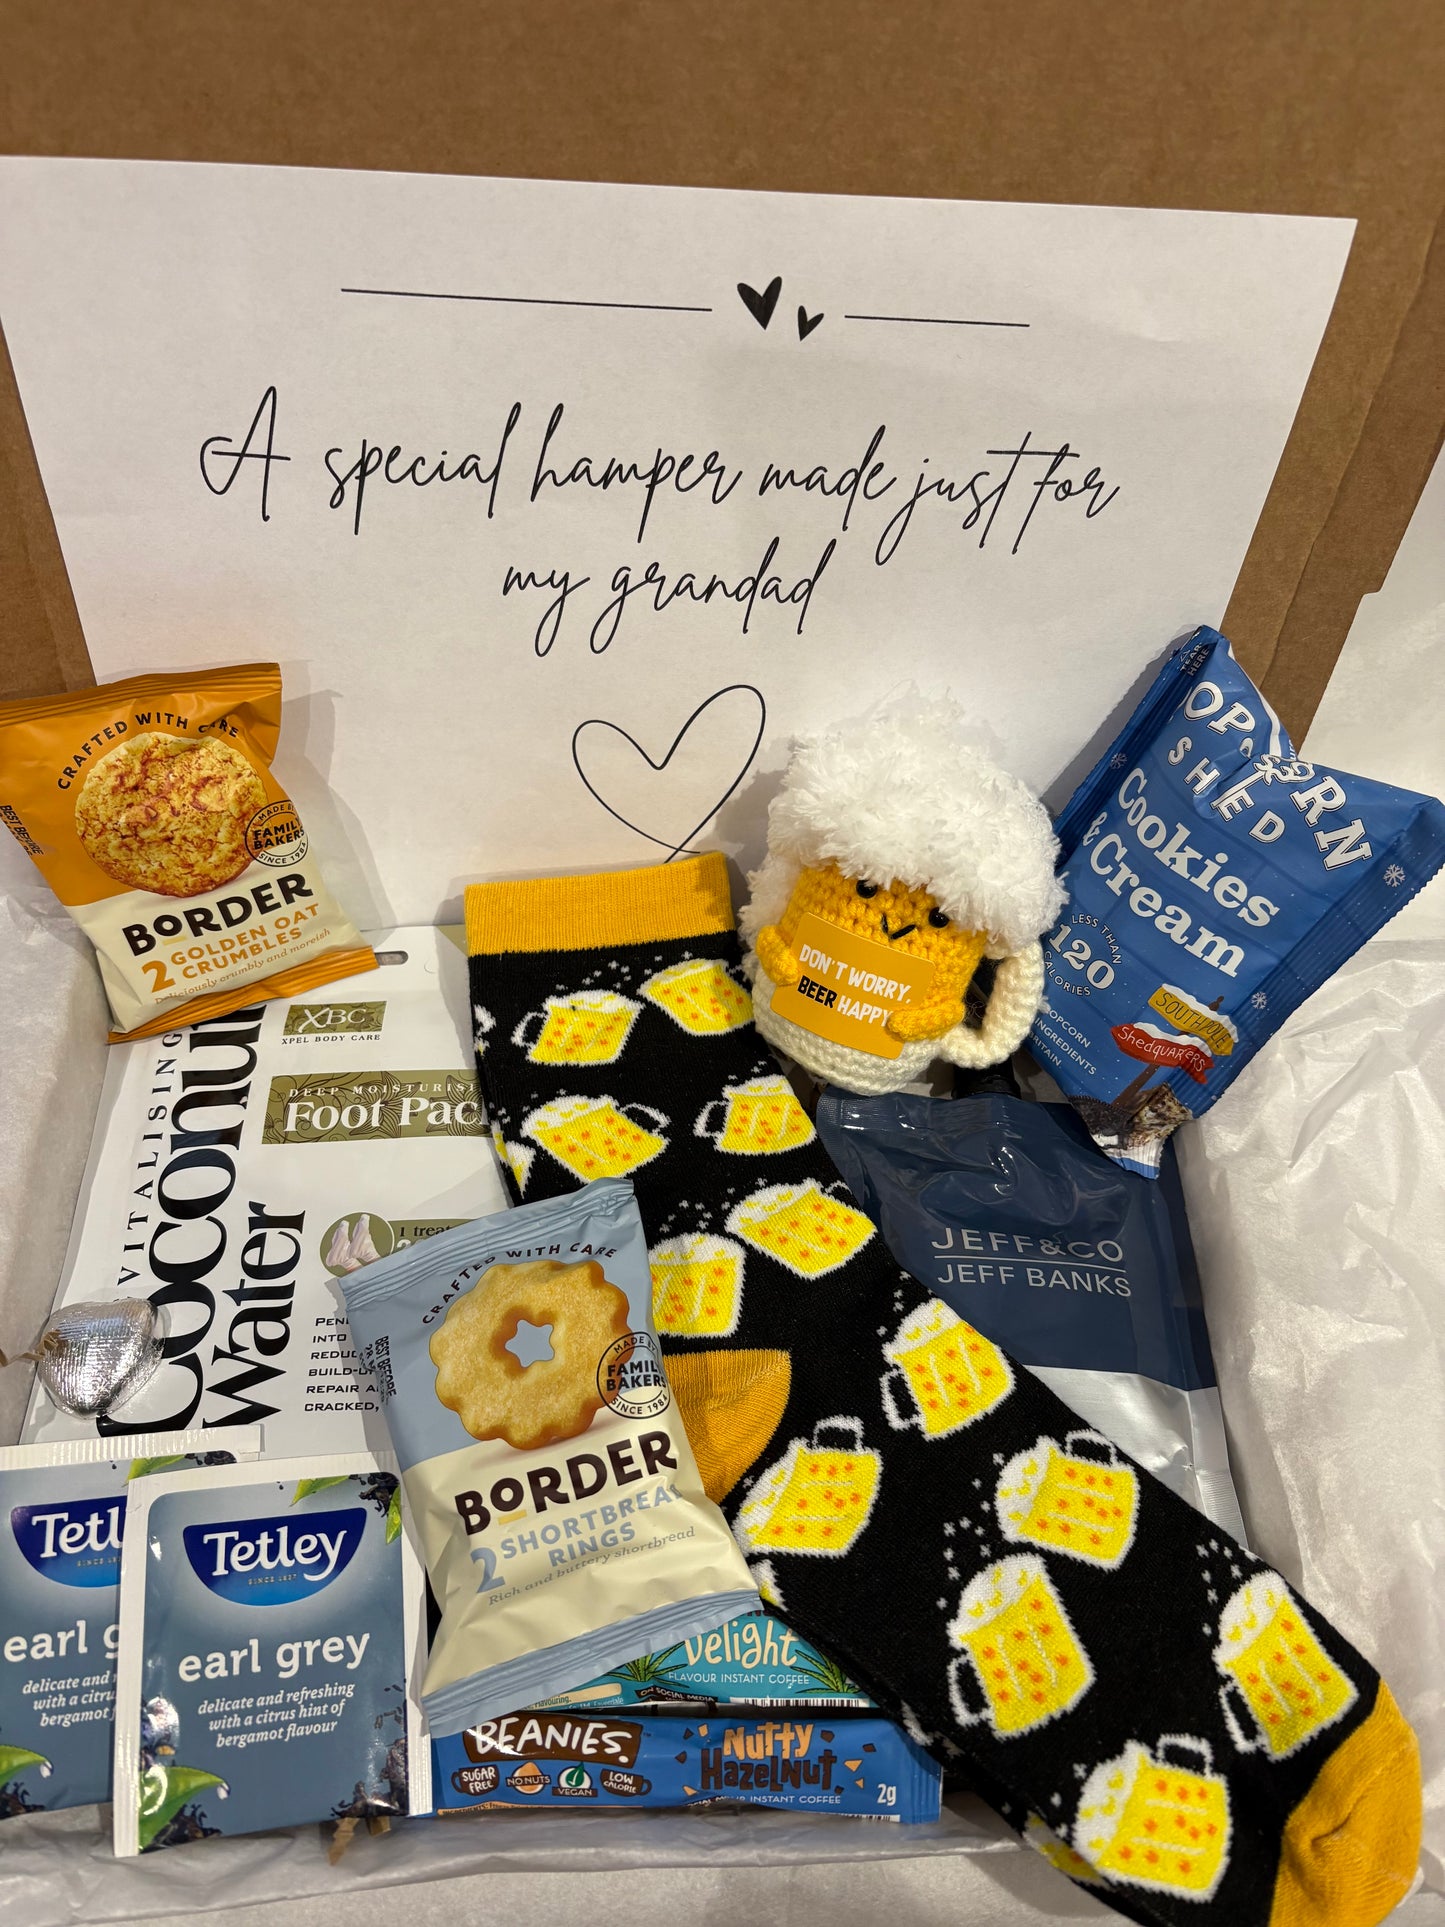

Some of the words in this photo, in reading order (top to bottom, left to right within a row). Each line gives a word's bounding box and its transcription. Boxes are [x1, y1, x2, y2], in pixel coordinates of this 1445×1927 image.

[200, 386, 291, 521] A
[325, 402, 521, 535] special
[530, 403, 742, 543] hamper
[759, 425, 897, 531] made
[875, 431, 1050, 566] just
[1012, 443, 1120, 554] for
[503, 566, 590, 657] my
[590, 536, 836, 654] grandad
[1187, 648, 1210, 676] HERE
[58, 721, 128, 790] CRAFTED
[135, 712, 188, 729] WITH
[1168, 736, 1285, 843] SHED
[258, 803, 285, 820] MADE
[254, 826, 305, 850] BAKERS
[1082, 811, 1107, 846] &
[258, 853, 287, 865] SINCE
[290, 842, 306, 861] 1984
[1118, 767, 1280, 927] Cookies
[122, 873, 313, 957] BORDER
[1090, 833, 1245, 978] Cream
[170, 925, 267, 965] GOLDEN
[274, 903, 319, 929] OAT
[1072, 914, 1099, 928] LESS
[1101, 925, 1122, 964] THAN
[182, 927, 303, 979] CRUMBLES
[219, 959, 265, 983] crumbly
[266, 948, 288, 964] and
[290, 928, 331, 954] moreish
[1049, 923, 1115, 989] 120
[141, 960, 176, 993] 2
[799, 943, 848, 980] DON'T
[847, 967, 911, 1004] WORRY,
[1044, 950, 1091, 996] CALORIES
[797, 975, 838, 1008] BEER
[837, 995, 894, 1027] HAPPY
[298, 1007, 367, 1034] XBC
[281, 1036, 310, 1045] XPEL
[314, 1035, 346, 1043] BODY
[350, 1033, 381, 1042] CARE
[1034, 1017, 1097, 1076] INGREDIENTS
[289, 1086, 340, 1098] DEEP
[283, 1098, 386, 1132] Foot
[931, 1227, 1123, 1262] JEFF&CO
[422, 1256, 496, 1325] CRAFTED
[506, 1243, 561, 1258] WITH
[570, 1242, 616, 1258] CARE
[937, 1264, 1014, 1285] JEFF
[1026, 1267, 1132, 1297] BANKS
[202, 1201, 306, 1429] Water
[312, 1333, 347, 1343] INTO
[375, 1335, 390, 1359] BEST
[613, 1336, 645, 1353] MADE
[606, 1374, 667, 1391] BAKERS
[607, 1360, 659, 1377] FAMIL
[306, 1385, 360, 1394] REPAIR
[611, 1396, 643, 1414] SINCE
[647, 1394, 668, 1412] 1984
[304, 1402, 380, 1413] CRACKED,
[454, 1430, 678, 1536] BORDER
[203, 1525, 348, 1582] Tetley
[550, 1521, 636, 1567] RINGS
[470, 1548, 506, 1593] 2
[488, 1586, 522, 1606] Rich
[524, 1573, 553, 1592] and
[556, 1551, 611, 1579] buttery
[613, 1526, 697, 1556] shortbread
[4, 1619, 88, 1662] earl
[178, 1638, 261, 1682] earl
[276, 1632, 370, 1679] grey
[22, 1674, 79, 1694] delicate
[82, 1670, 110, 1688] and
[656, 1687, 685, 1699] SOCIAL
[668, 1671, 717, 1683] FLAVOUR
[721, 1673, 765, 1684] INSTANT
[769, 1673, 810, 1685] COFFEE
[33, 1693, 66, 1710] with
[69, 1695, 78, 1706] a
[81, 1688, 117, 1705] citru
[198, 1696, 254, 1715] delicate
[256, 1689, 284, 1706] and
[286, 1681, 356, 1702] refreshing
[40, 1708, 110, 1728] bergamot
[208, 1714, 242, 1731] with
[244, 1714, 253, 1727] a
[255, 1706, 296, 1725] citrus
[299, 1702, 329, 1719] hint
[330, 1699, 346, 1717] of
[216, 1728, 284, 1749] bergamot
[284, 1720, 338, 1742] flavour
[462, 1766, 497, 1782] SUGAR
[469, 1780, 494, 1794] FREE
[525, 1774, 550, 1785] NUTS
[603, 1780, 637, 1794] CALORIE
[609, 1771, 634, 1784] LOW
[557, 1787, 592, 1796] VEGAN
[750, 1795, 794, 1804] INSTANT
[799, 1795, 841, 1804] COFFEE
[877, 1783, 897, 1806] 2g
